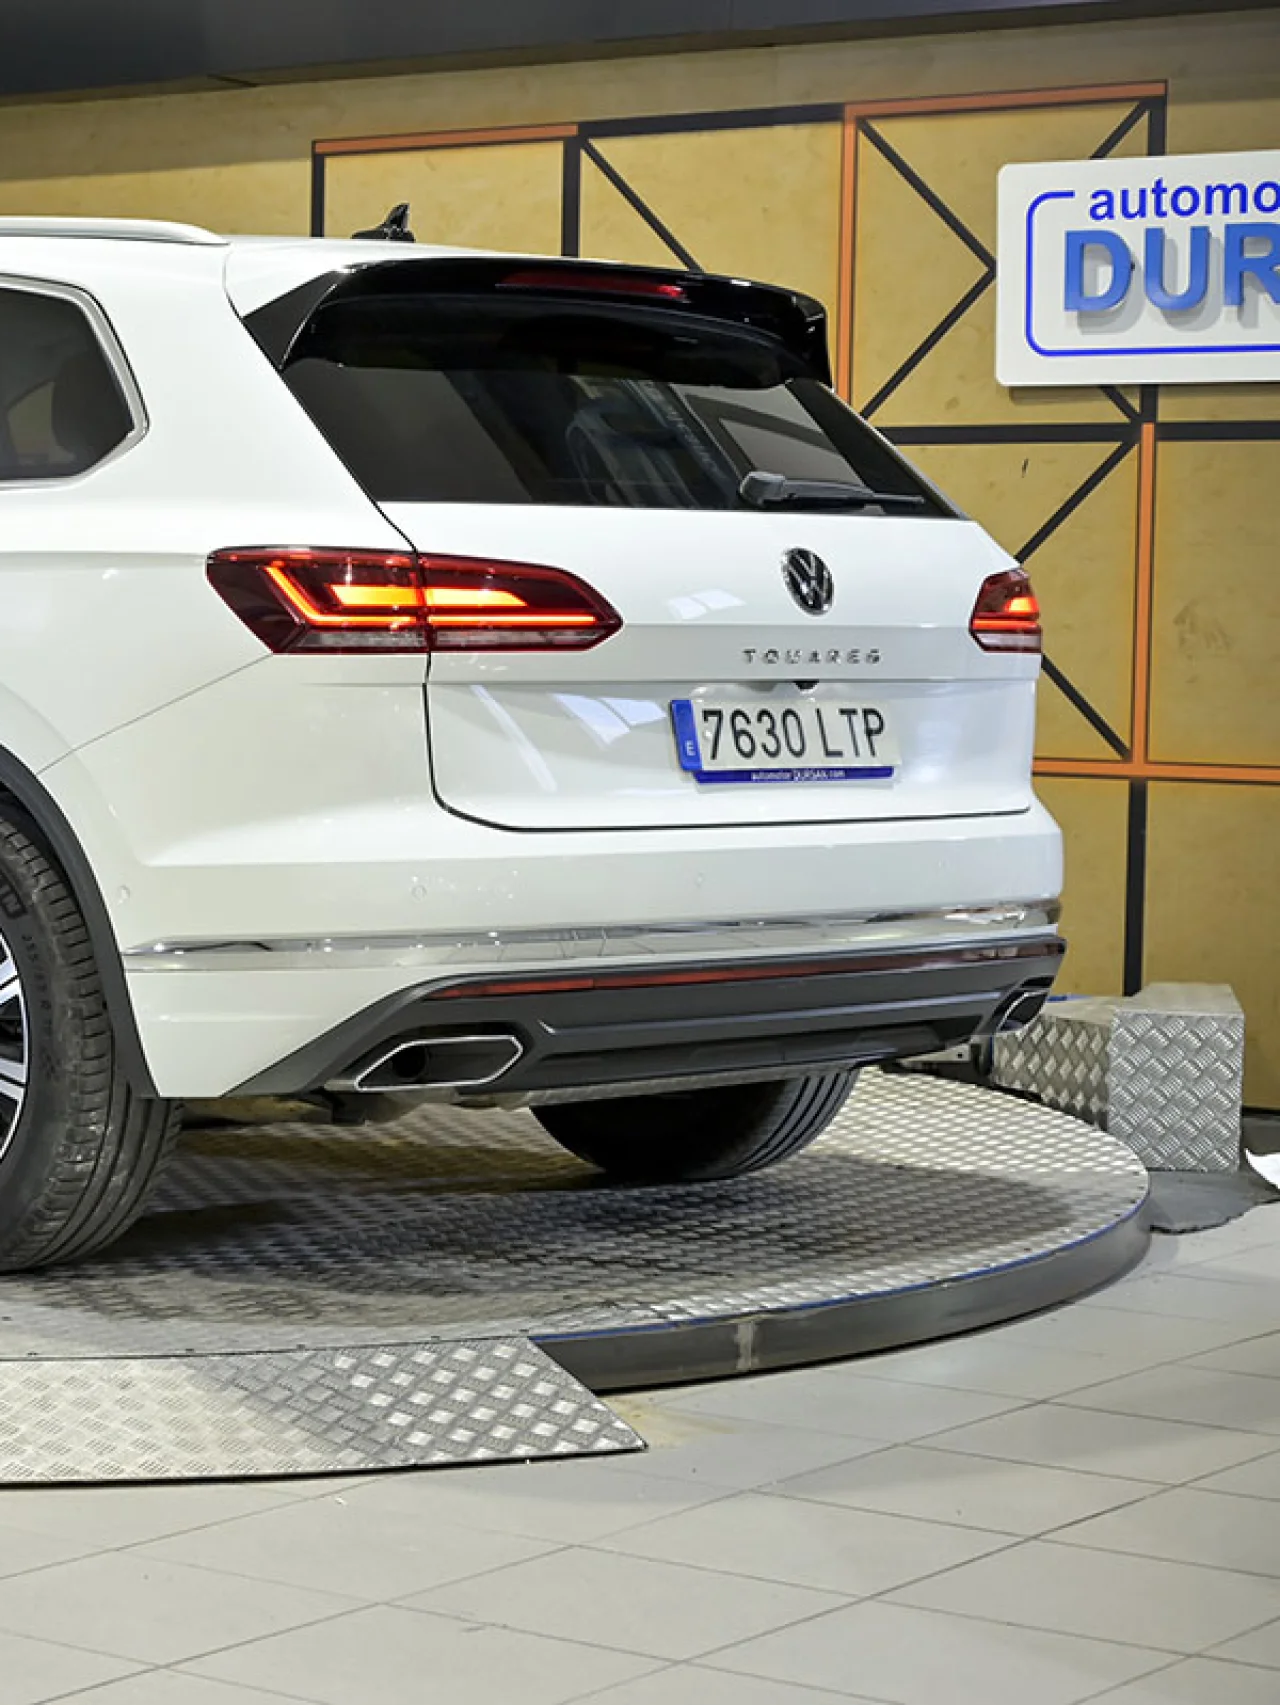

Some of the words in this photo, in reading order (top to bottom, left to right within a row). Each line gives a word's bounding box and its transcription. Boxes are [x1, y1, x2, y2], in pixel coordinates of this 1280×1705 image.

[1089, 177, 1280, 220] automo
[1064, 222, 1280, 312] DUR
[742, 648, 881, 664] TOUAREG
[685, 741, 696, 757] E
[701, 707, 807, 760] 7630
[815, 707, 885, 758] LTP
